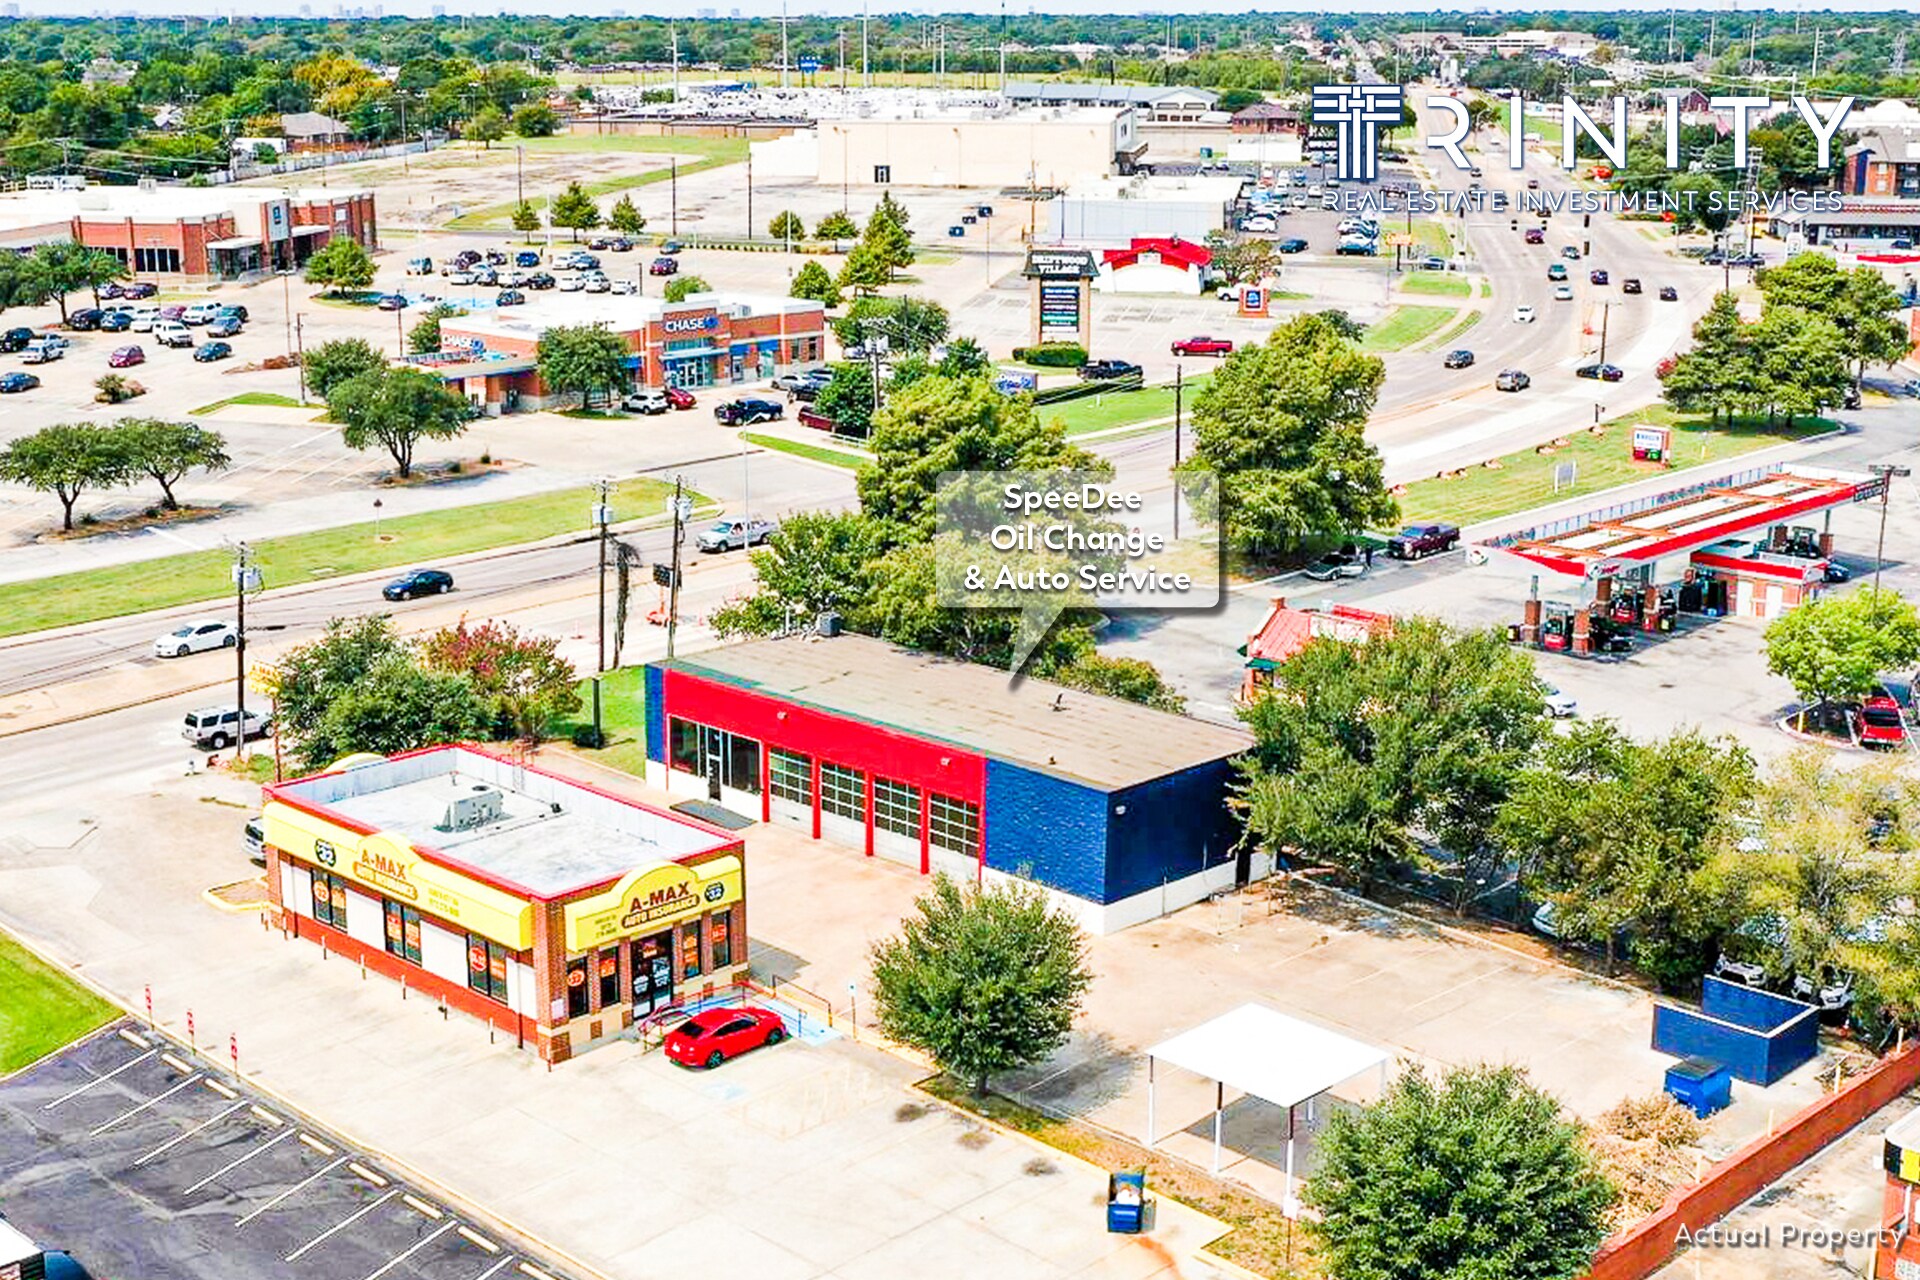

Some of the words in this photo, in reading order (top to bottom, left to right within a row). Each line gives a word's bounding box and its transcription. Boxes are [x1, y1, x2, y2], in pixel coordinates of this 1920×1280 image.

[665, 317, 705, 333] CHASE
[361, 849, 406, 880] A-MAX
[624, 910, 648, 928] AUTO
[648, 894, 697, 920] INSURANCE
[630, 881, 690, 913] A-MAX
